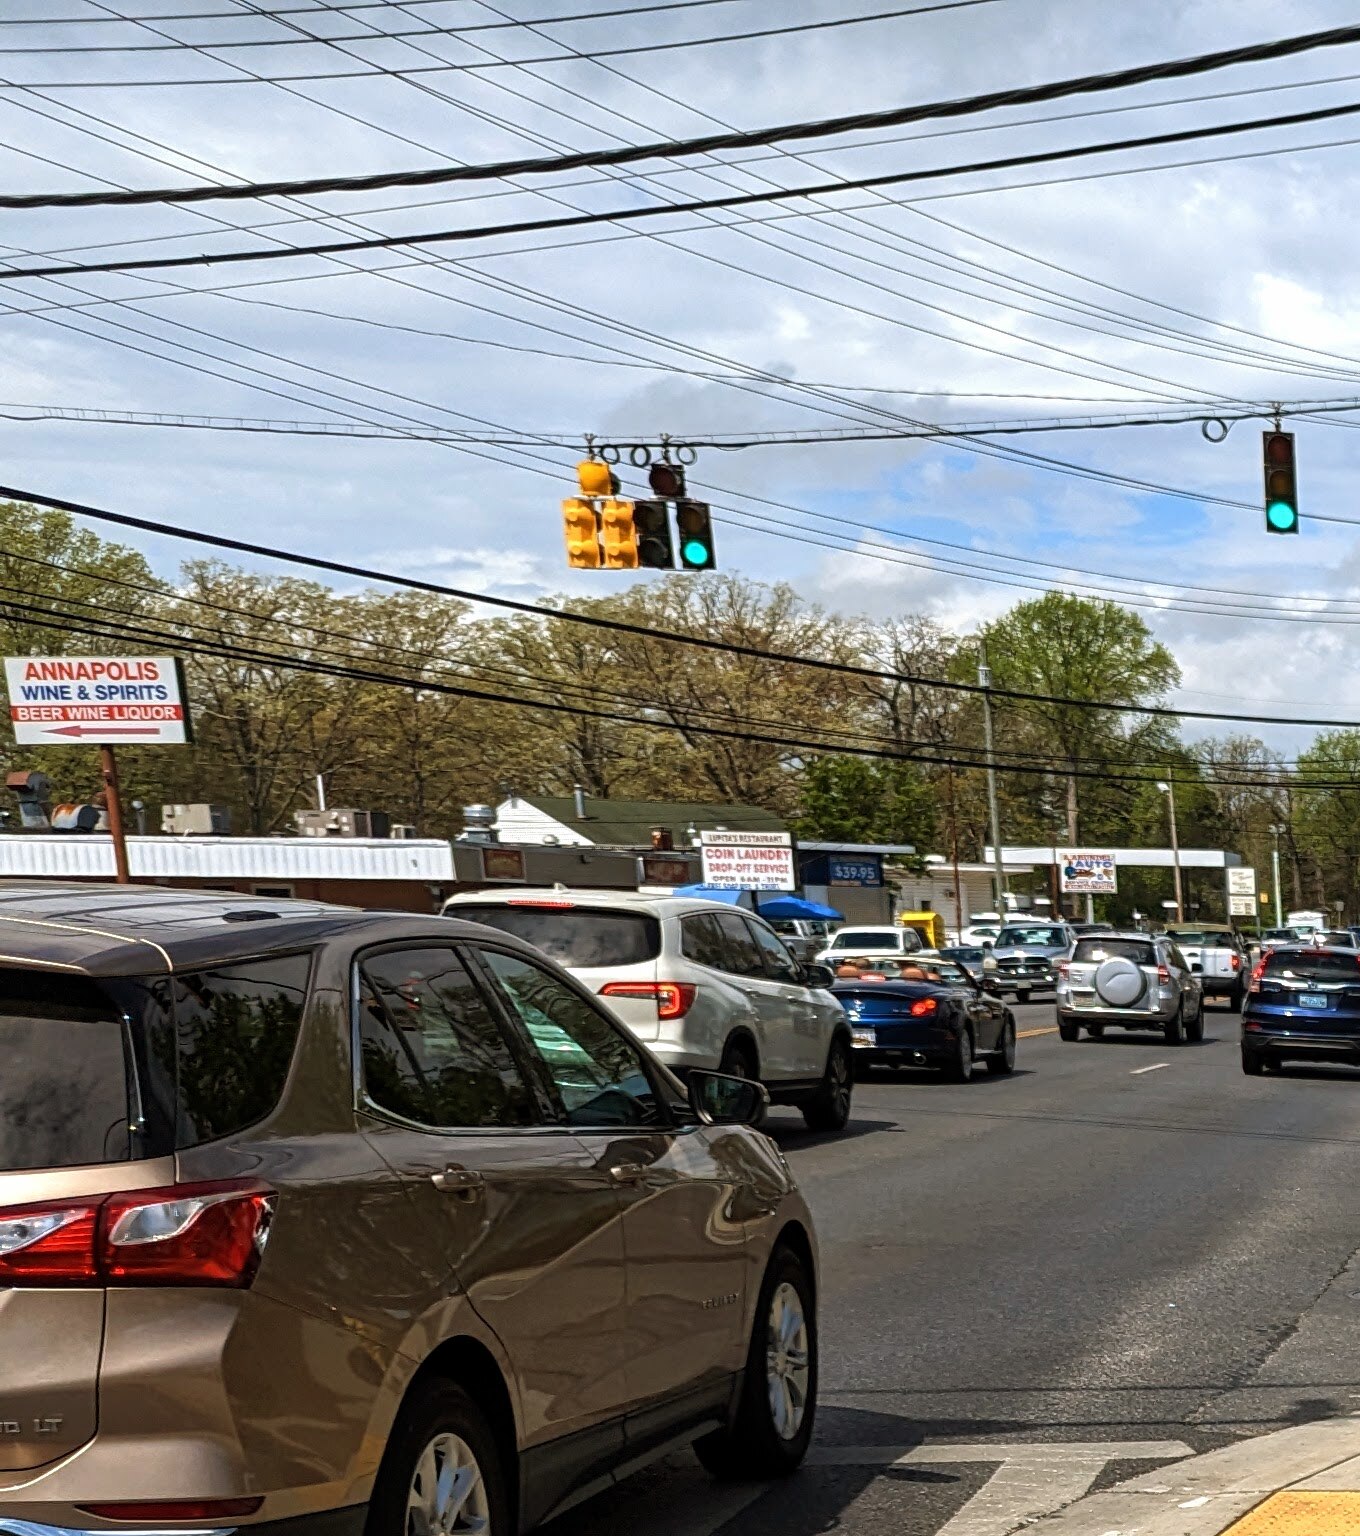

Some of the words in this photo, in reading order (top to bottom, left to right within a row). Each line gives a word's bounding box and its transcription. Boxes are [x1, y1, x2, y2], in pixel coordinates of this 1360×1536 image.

[25, 661, 160, 681] ANNAPOLIS
[21, 685, 71, 700] WINE
[77, 685, 91, 700] &
[95, 685, 168, 700] SPIRITS
[17, 707, 64, 720] BEER
[66, 707, 110, 720] WINE
[113, 706, 177, 720] LIQUOR
[739, 835, 783, 843] RESTAURANT
[705, 848, 735, 859] COIN
[737, 849, 790, 861] LAUNDRY
[708, 862, 751, 873] DROP-OFF
[753, 864, 789, 874] SERVICE
[1075, 860, 1112, 868] AUTO
[834, 865, 875, 879] $39.95
[33, 1418, 63, 1432] LT
